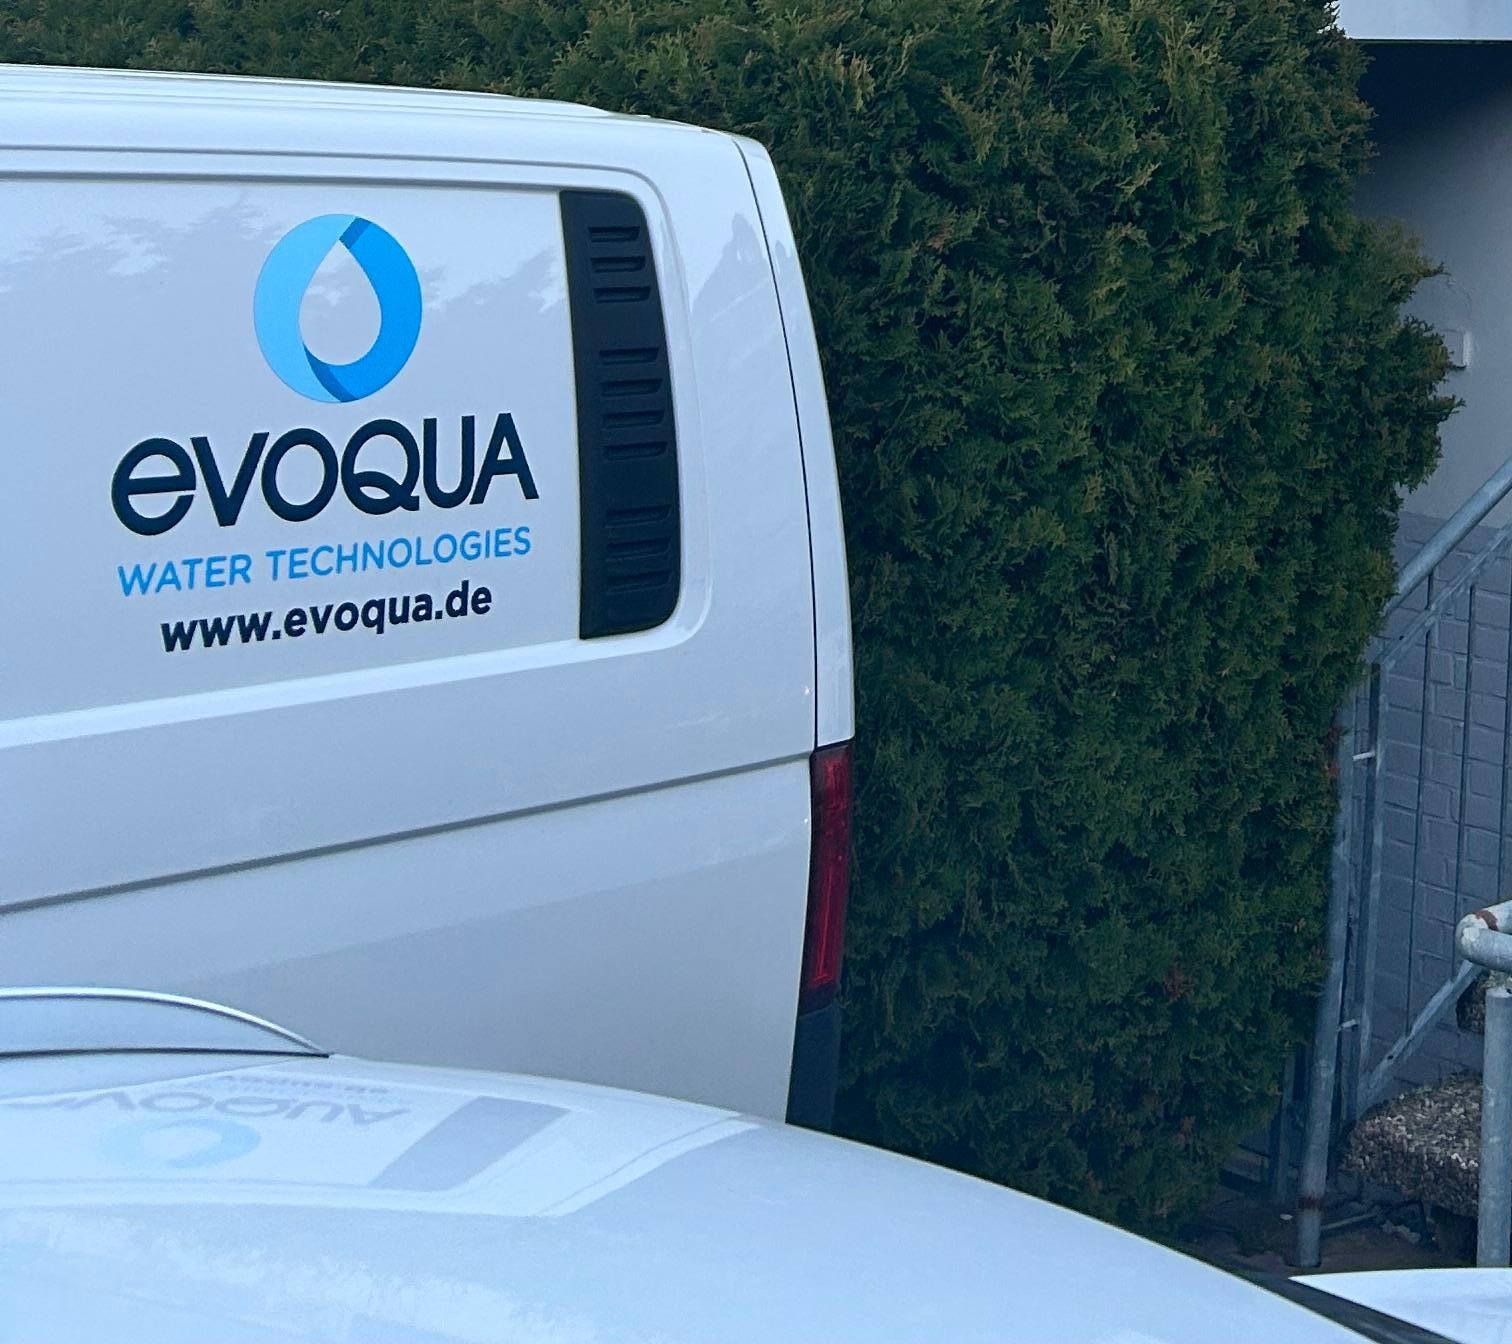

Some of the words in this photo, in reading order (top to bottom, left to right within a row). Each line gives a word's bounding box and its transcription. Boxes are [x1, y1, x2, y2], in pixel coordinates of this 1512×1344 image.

[117, 552, 253, 598] WATER
[264, 525, 533, 583] TECHNOLOGIES
[160, 579, 493, 654] www.evoqua.de
